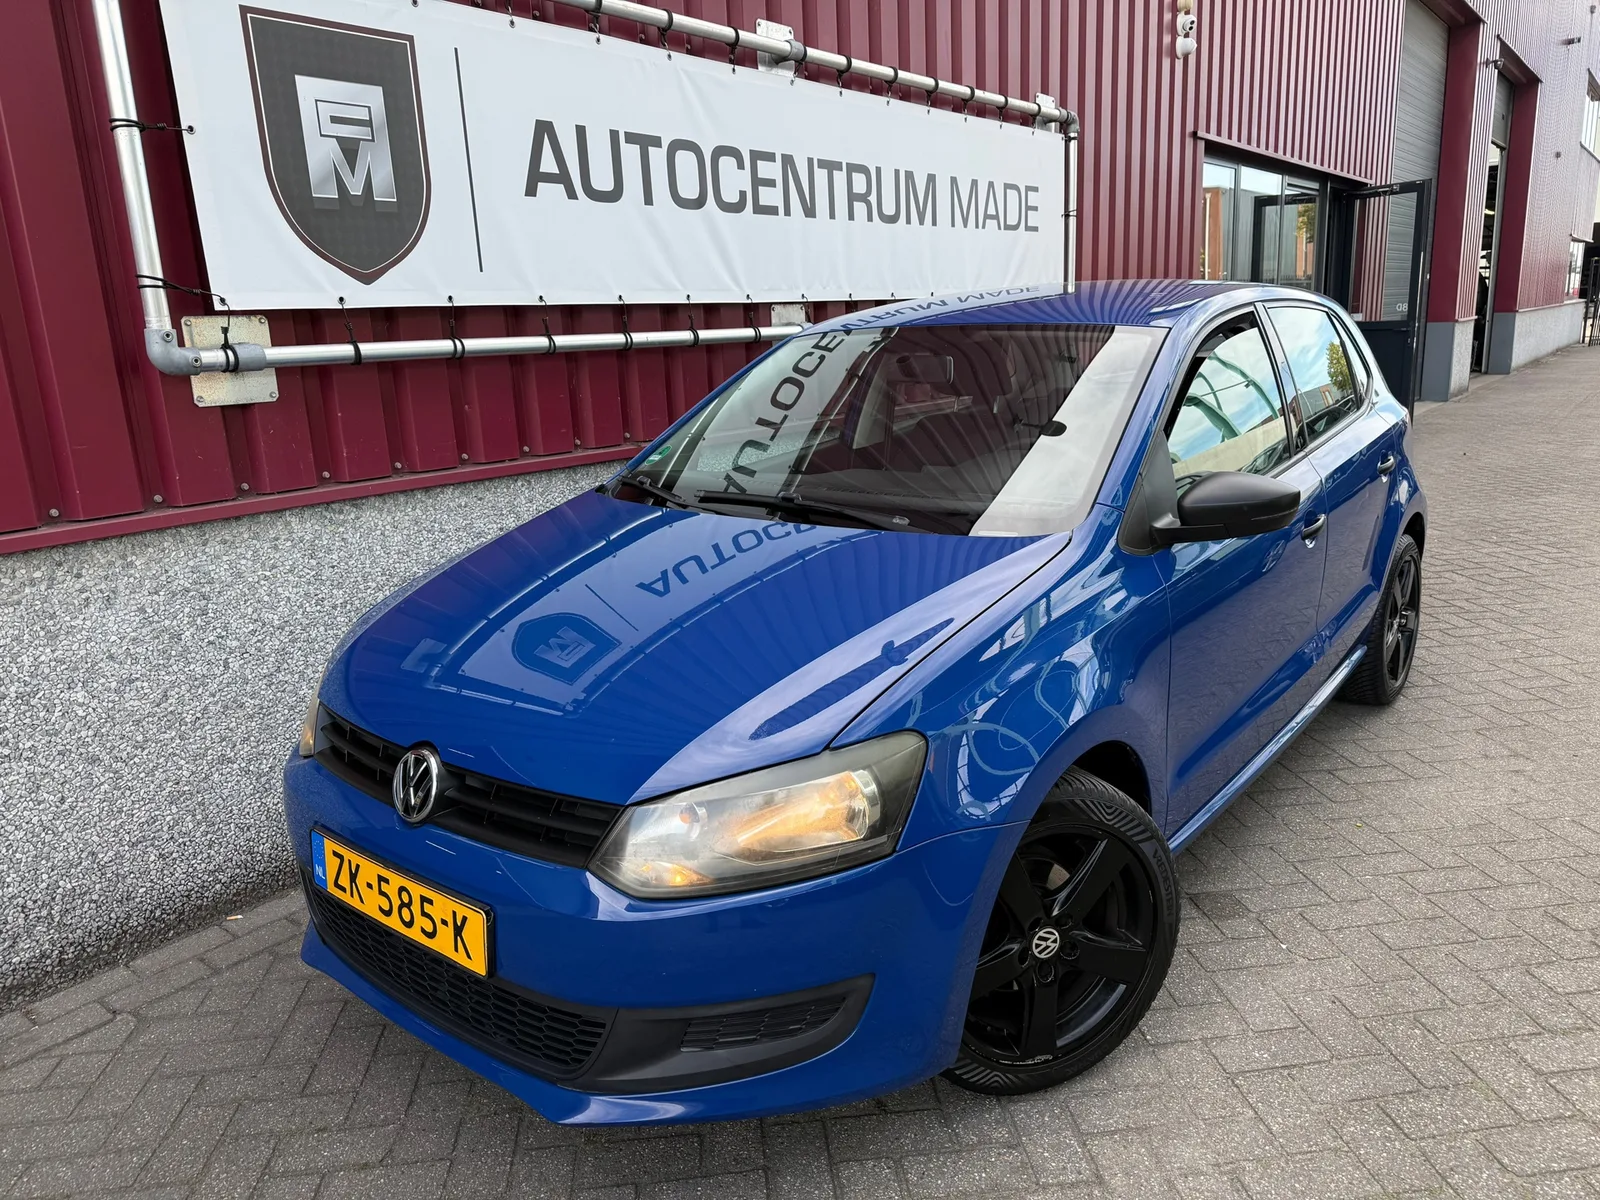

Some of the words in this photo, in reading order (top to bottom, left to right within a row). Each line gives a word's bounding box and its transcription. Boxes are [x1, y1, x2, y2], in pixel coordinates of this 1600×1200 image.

[524, 119, 938, 228] AUTOCENTRUM
[949, 175, 1039, 233] MADE
[315, 863, 326, 880] NL
[332, 849, 473, 961] ZK-585-K
